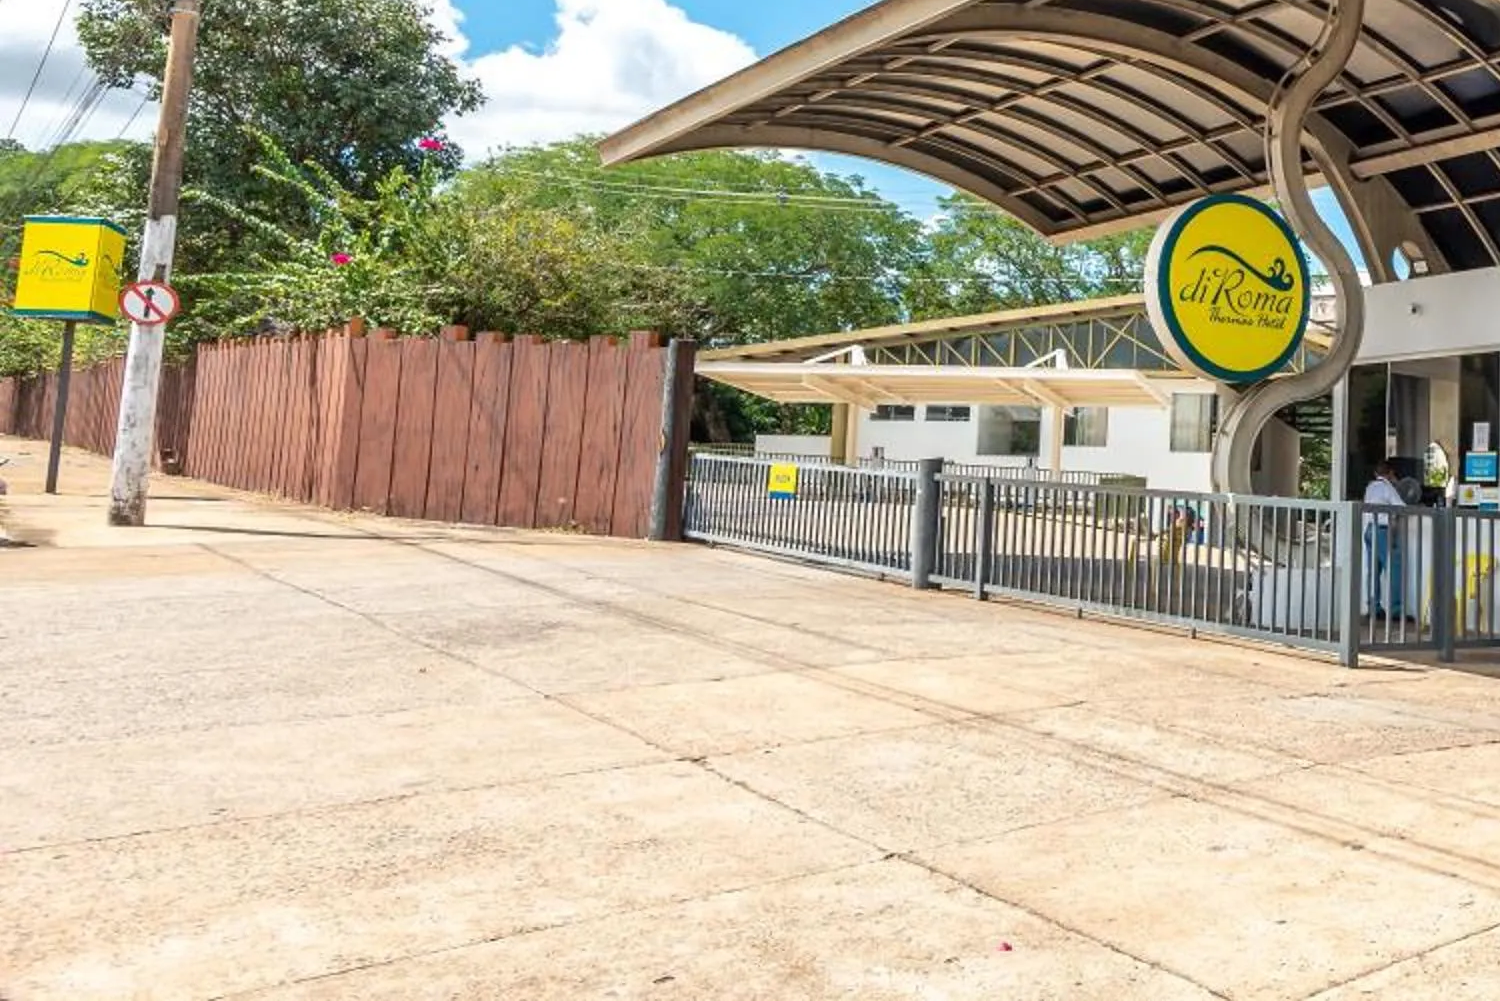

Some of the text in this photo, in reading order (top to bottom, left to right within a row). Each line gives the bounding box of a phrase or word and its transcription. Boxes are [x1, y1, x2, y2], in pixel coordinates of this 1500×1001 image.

[1179, 267, 1294, 315] diRoma
[1210, 307, 1286, 329] Thermas Hotel
